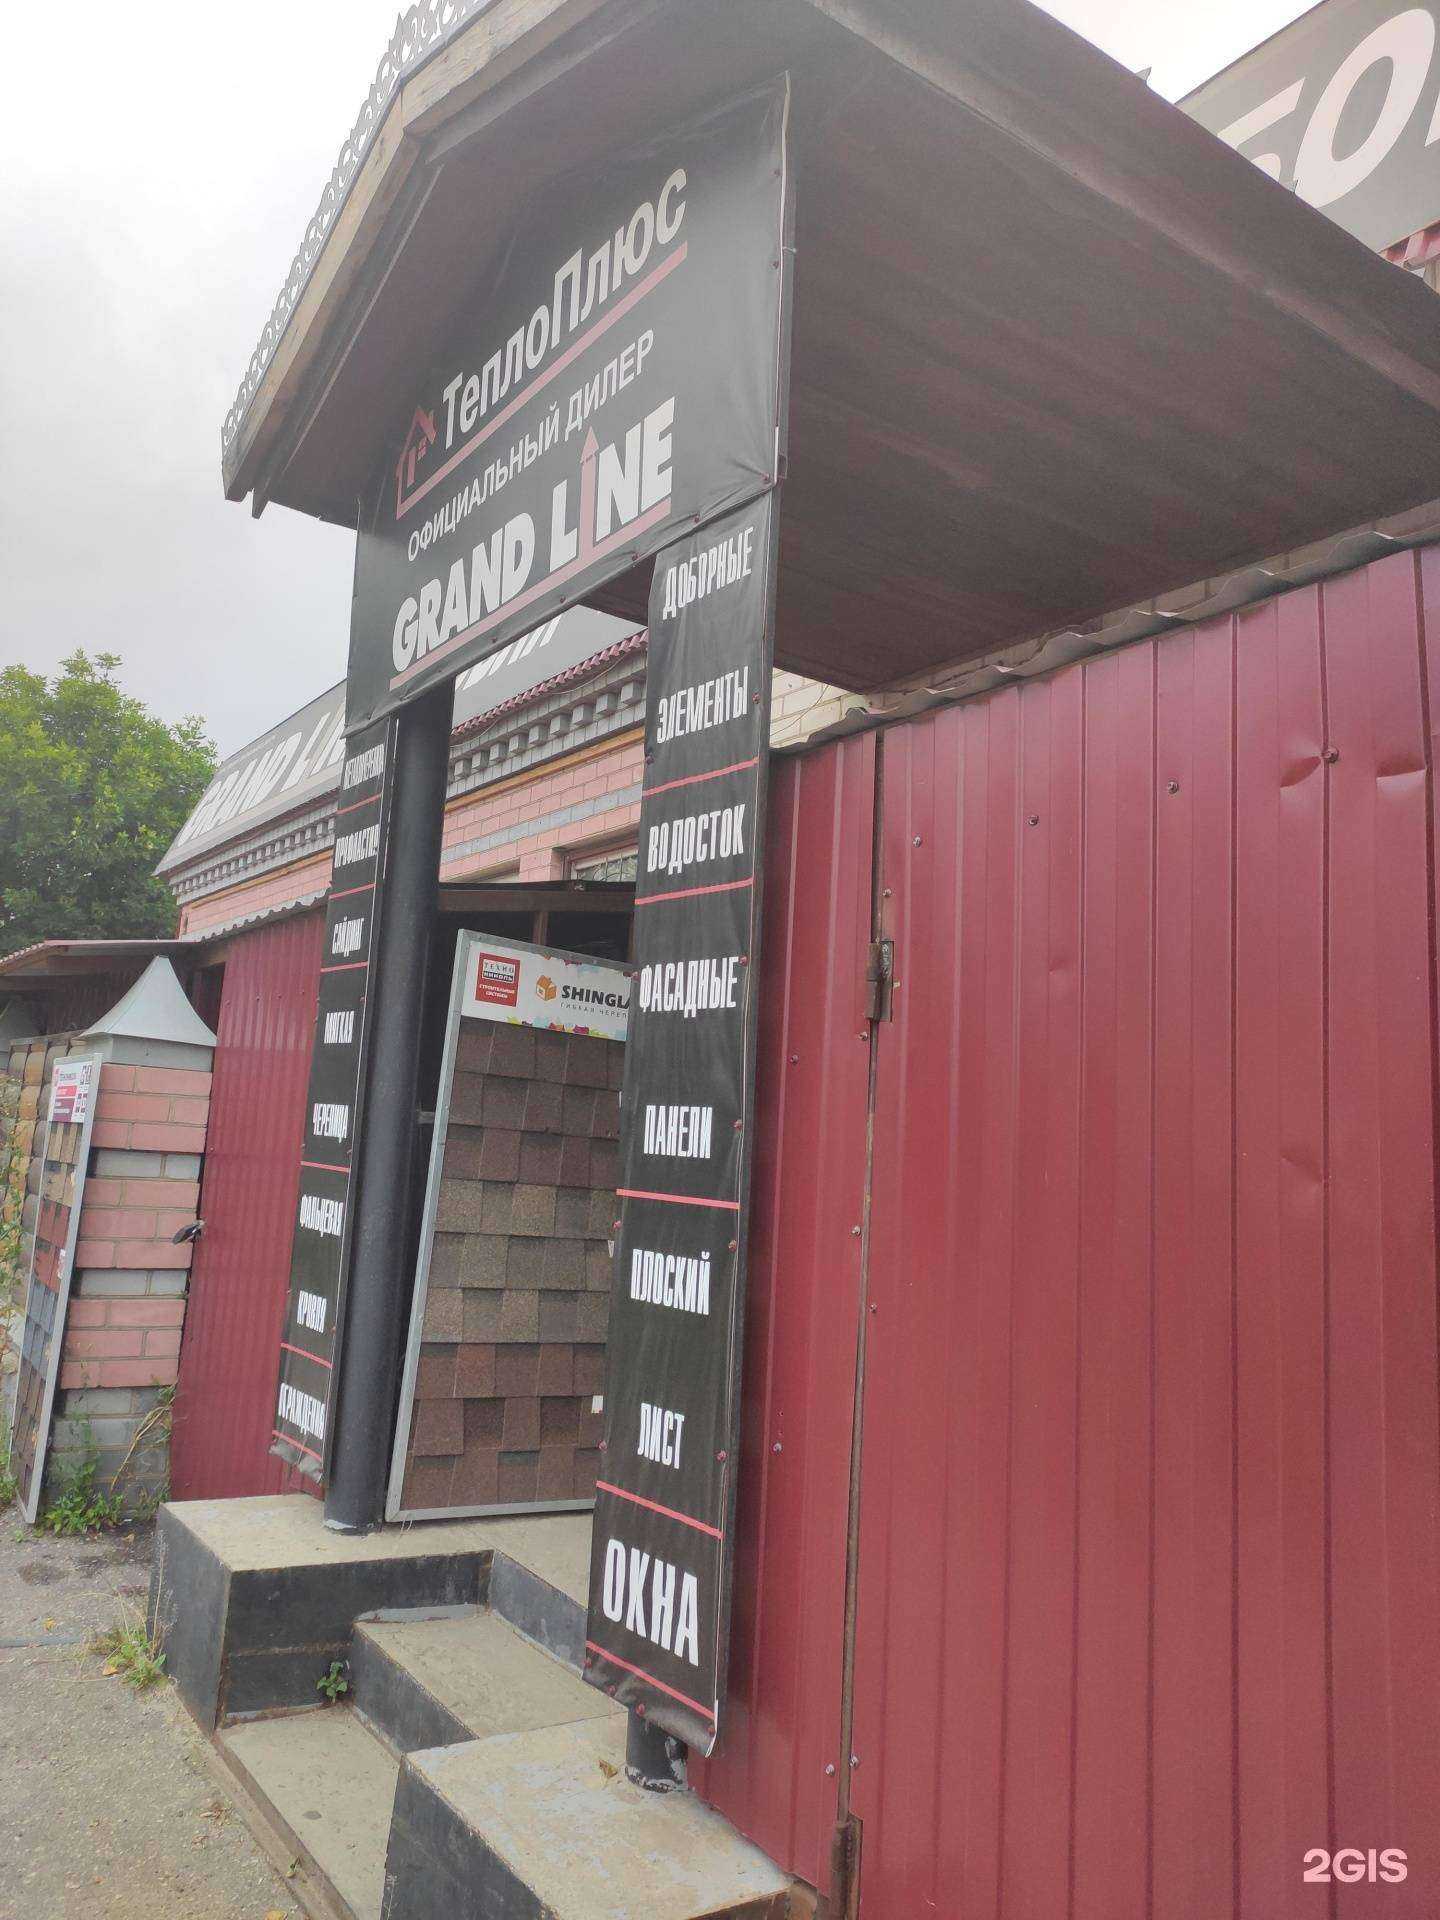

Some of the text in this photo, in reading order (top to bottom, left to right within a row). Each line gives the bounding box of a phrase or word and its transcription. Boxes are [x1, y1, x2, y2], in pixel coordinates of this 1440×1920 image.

[407, 329, 654, 562] ОФИЦИАЛЬНЫЙ ДИЛЕР
[393, 512, 535, 672] GRAND
[662, 527, 754, 620] ДОБОРНЫЕ
[656, 666, 749, 745] ЭЛЕМЕНТЫ
[177, 731, 303, 847] GRAND
[647, 804, 747, 876] ВОДОСТОК
[331, 916, 364, 958] САЙДИНГ
[638, 957, 740, 1018] ФАСАДНЫЕ
[323, 1010, 354, 1044] МЯГКАЯ
[312, 1103, 349, 1144] ЧЕРЕПИЦА
[643, 1105, 713, 1160] ПАНЕЛИ
[300, 1194, 344, 1238] ФАЛЬЦЕВАЯ
[296, 1290, 328, 1334] КРОВЛЯ
[630, 1248, 711, 1316] ПЛОСКИЙ
[637, 1402, 686, 1470] ЛИСТ
[602, 1538, 700, 1668] ОКНА
